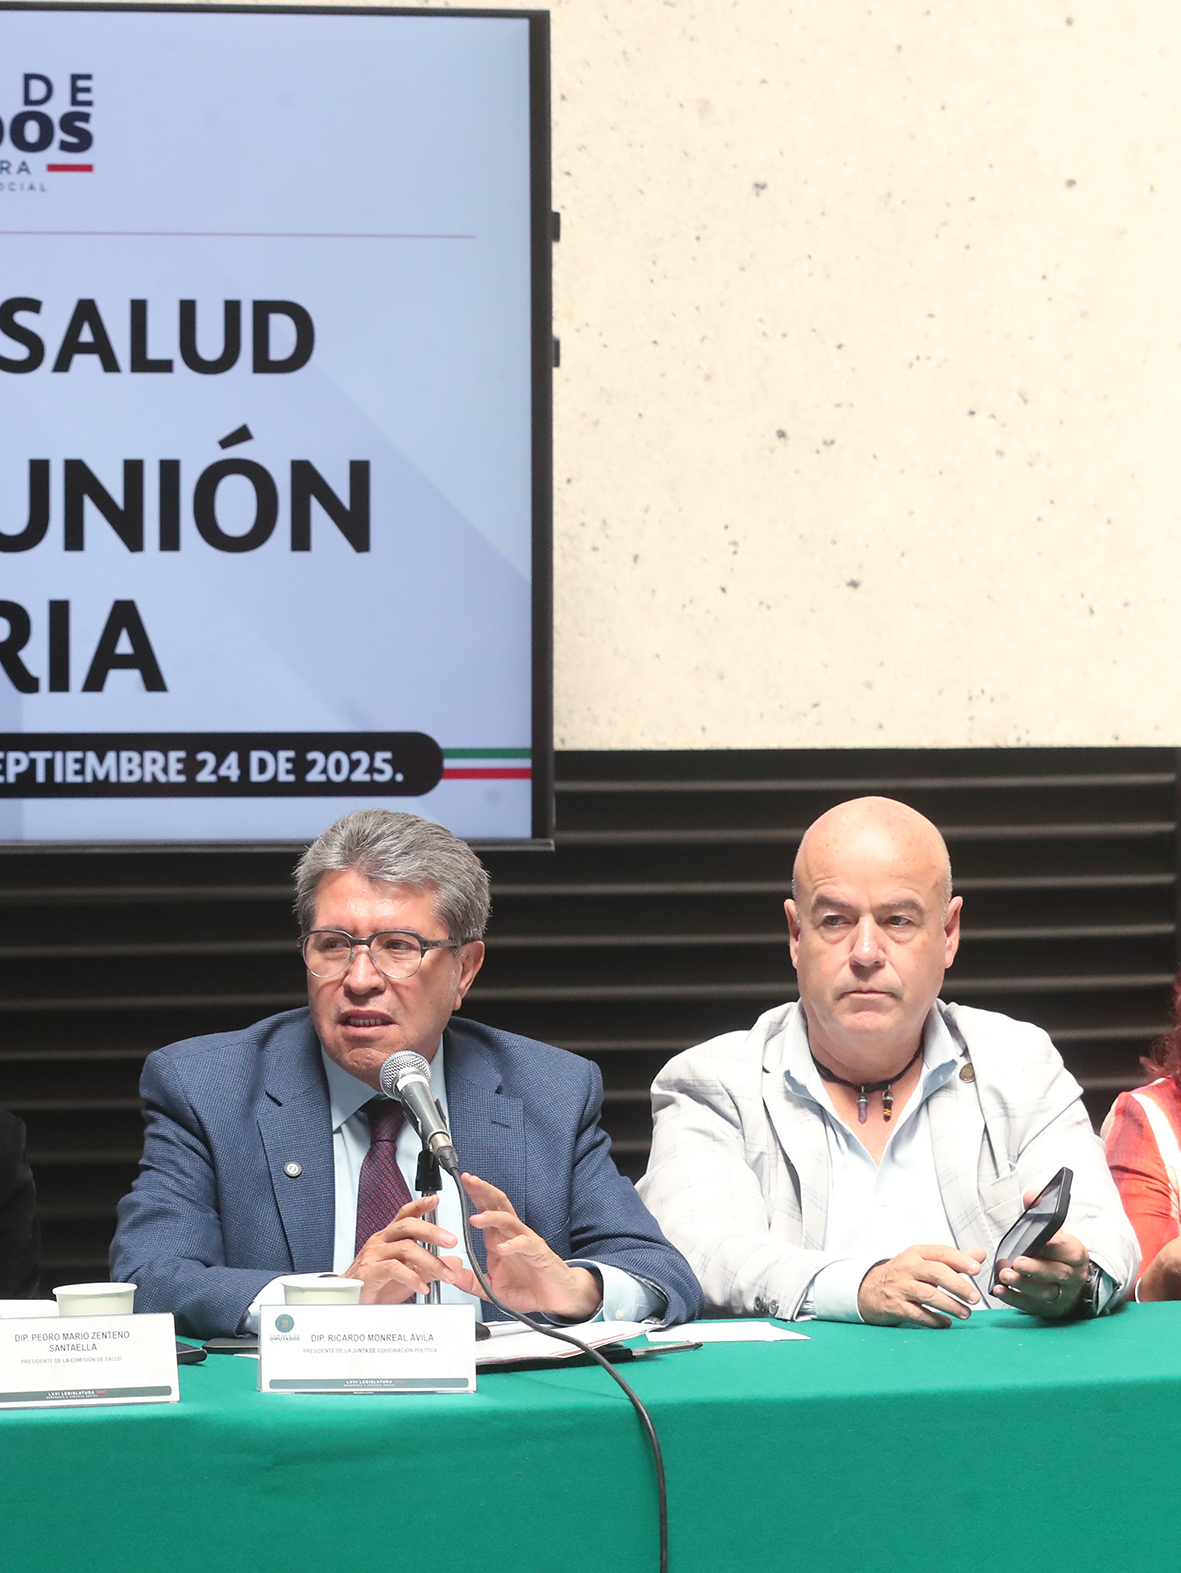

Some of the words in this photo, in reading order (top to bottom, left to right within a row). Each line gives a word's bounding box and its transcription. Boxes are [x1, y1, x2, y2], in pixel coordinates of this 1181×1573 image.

[23, 73, 94, 107] DE
[195, 750, 241, 783] 24
[249, 750, 296, 783] DE
[305, 750, 405, 783] 2025.
[15, 1334, 29, 1342] DIP.
[31, 1333, 60, 1341] PEDRO
[63, 1332, 89, 1340] MARIO
[91, 1331, 130, 1340] ZENTENO
[311, 1334, 325, 1342] DIP.
[327, 1334, 365, 1342] RICARDO
[367, 1334, 408, 1342] MONREAL
[409, 1332, 434, 1342] ÁVILA
[49, 1343, 97, 1352] SANTAELLA
